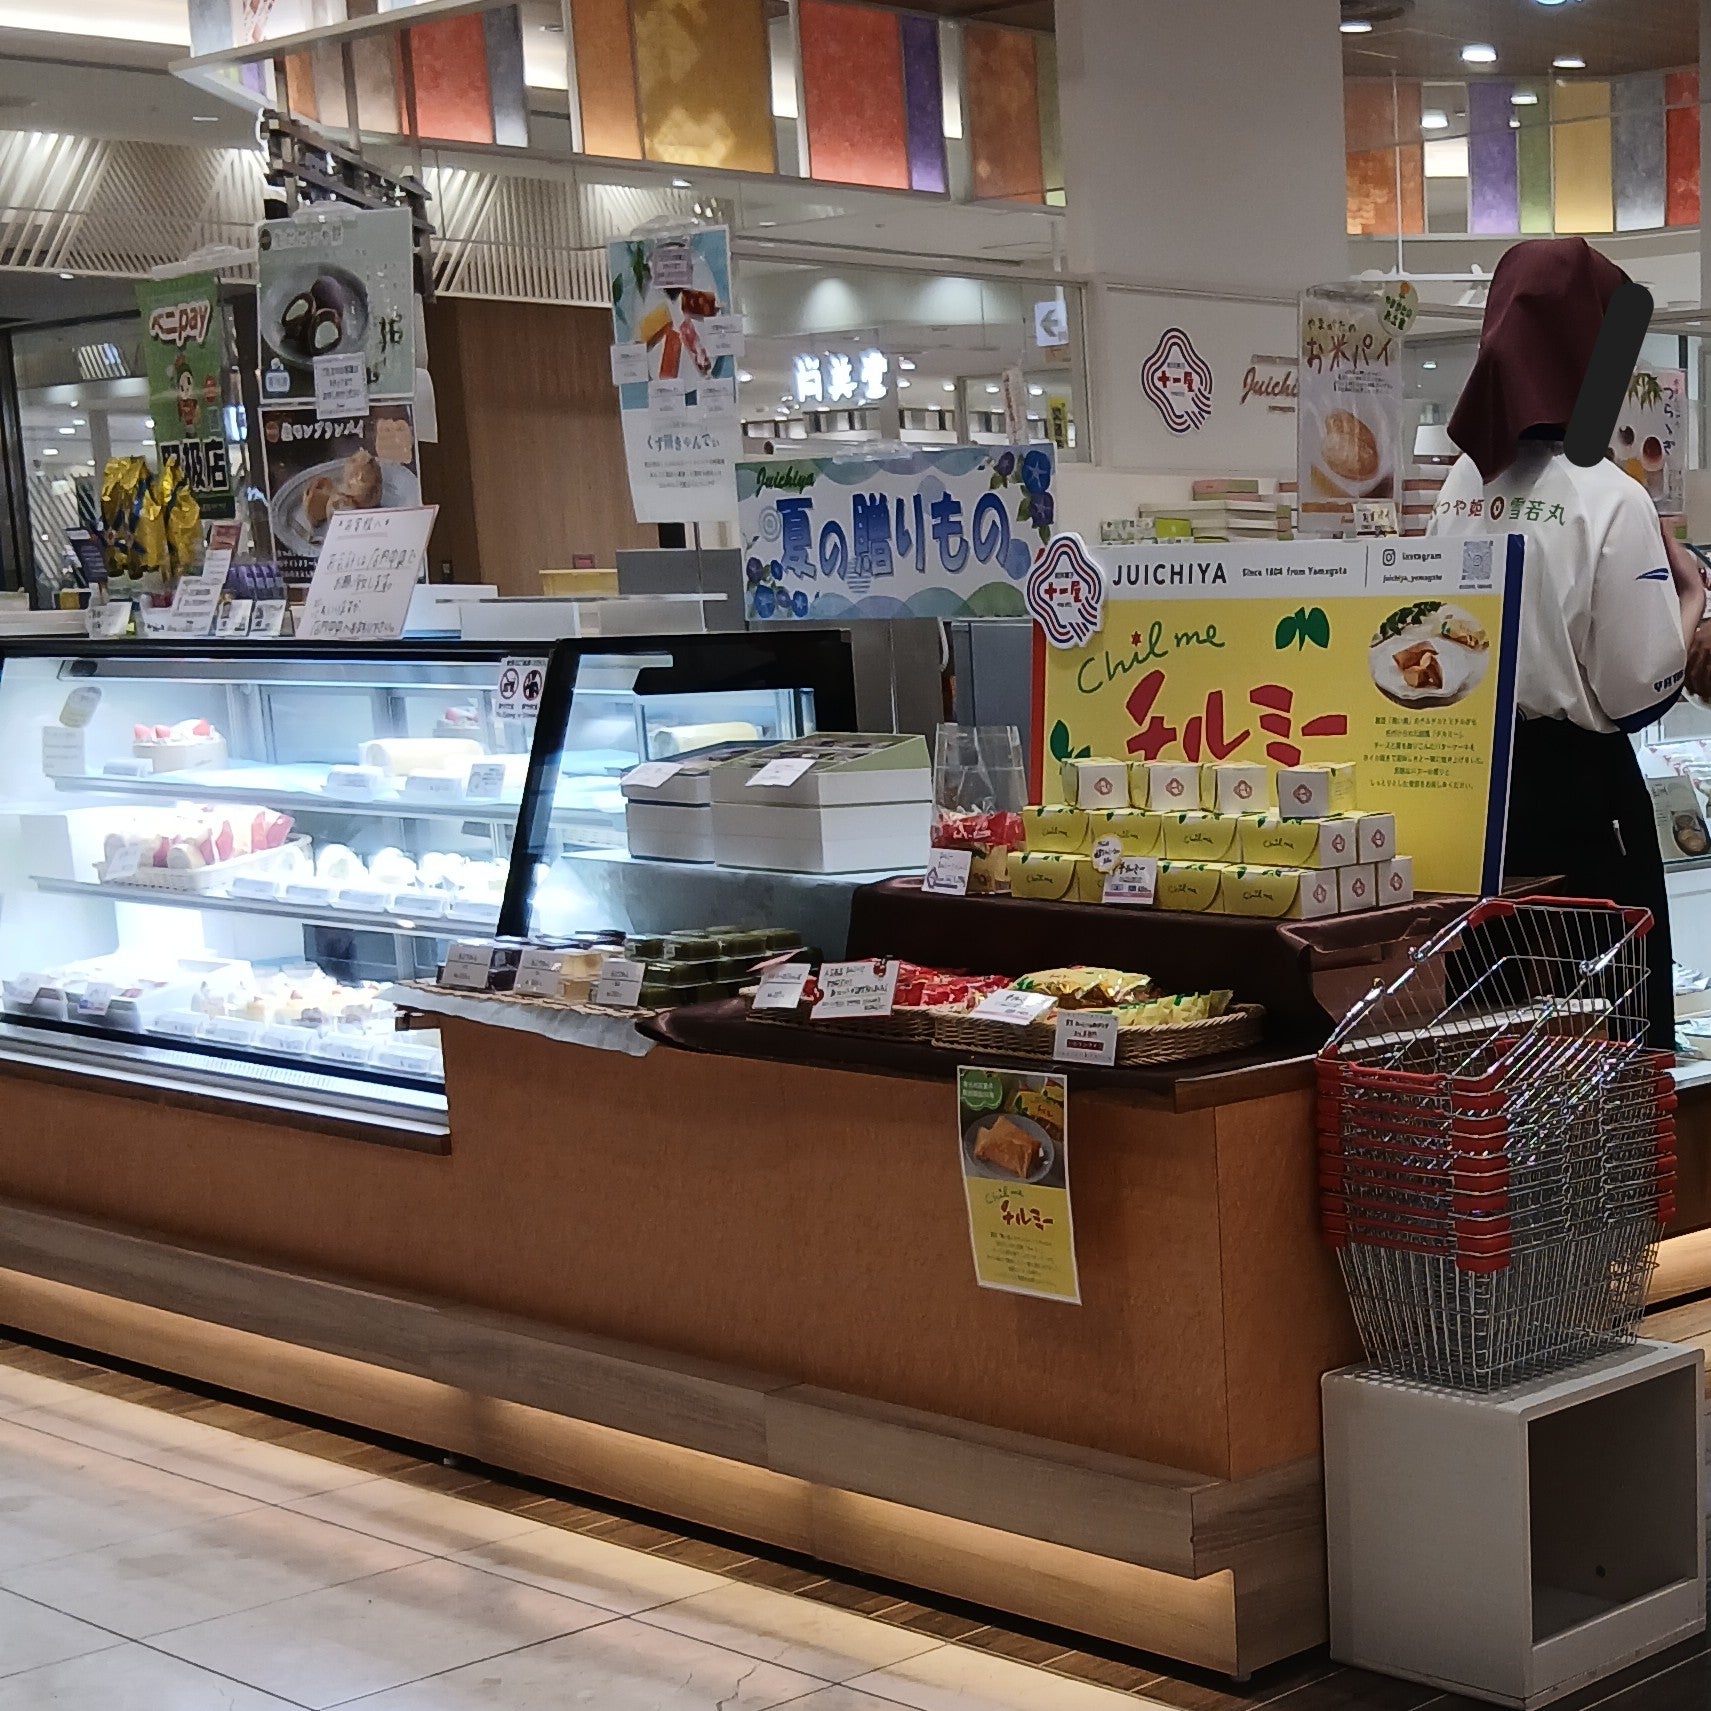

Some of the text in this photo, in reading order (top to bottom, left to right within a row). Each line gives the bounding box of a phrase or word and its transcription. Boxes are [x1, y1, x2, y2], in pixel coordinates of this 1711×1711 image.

[1306, 333, 1393, 375] お米パイ
[1157, 370, 1195, 392] 十一屋
[756, 465, 816, 497] Juichiya
[1441, 497, 1566, 526] つや姫 雪若丸
[776, 491, 1010, 580] 夏の贈りもの
[1112, 563, 1227, 586] JUICHIYA
[1286, 567, 1306, 576] from
[1044, 581, 1082, 603] 十一屋
[1077, 620, 1226, 694] Chil me
[1126, 669, 1348, 768] チルミー
[1001, 1199, 1054, 1230] チルミー
